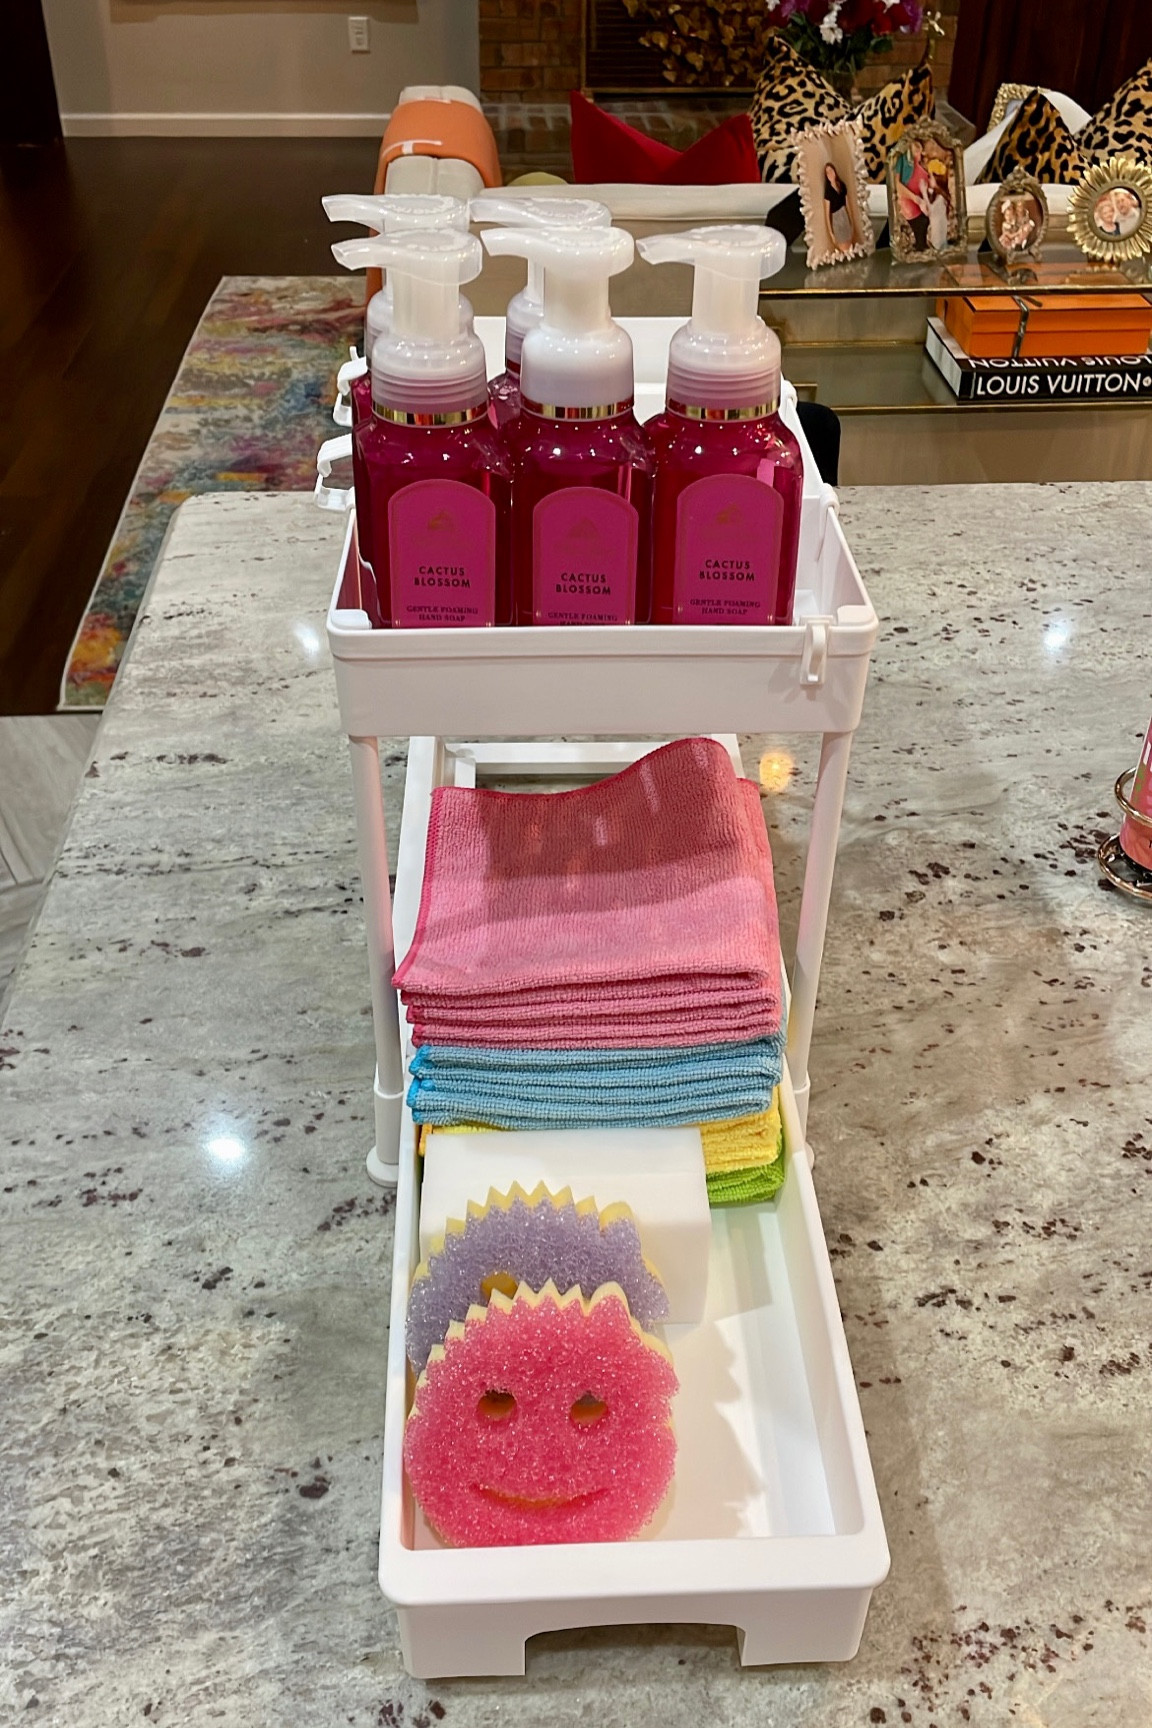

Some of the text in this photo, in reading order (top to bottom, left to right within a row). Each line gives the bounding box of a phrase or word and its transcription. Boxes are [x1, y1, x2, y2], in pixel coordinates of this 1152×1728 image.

[976, 372, 1142, 396] LOUIS VUITTON
[705, 559, 751, 570] CACTUS
[418, 565, 466, 577] CACTUS
[699, 570, 755, 582] BLOSSOM
[413, 577, 471, 589] BLOSSOM
[560, 572, 607, 583] CACTUS
[555, 583, 611, 595] BLOSSOM
[689, 598, 761, 609] GENTLE FOAMING
[406, 604, 479, 615] GENTLE FOAMING
[701, 607, 748, 616] HAND SOAP
[418, 613, 466, 622] HAND SOAP
[547, 611, 579, 620] GENTLE
